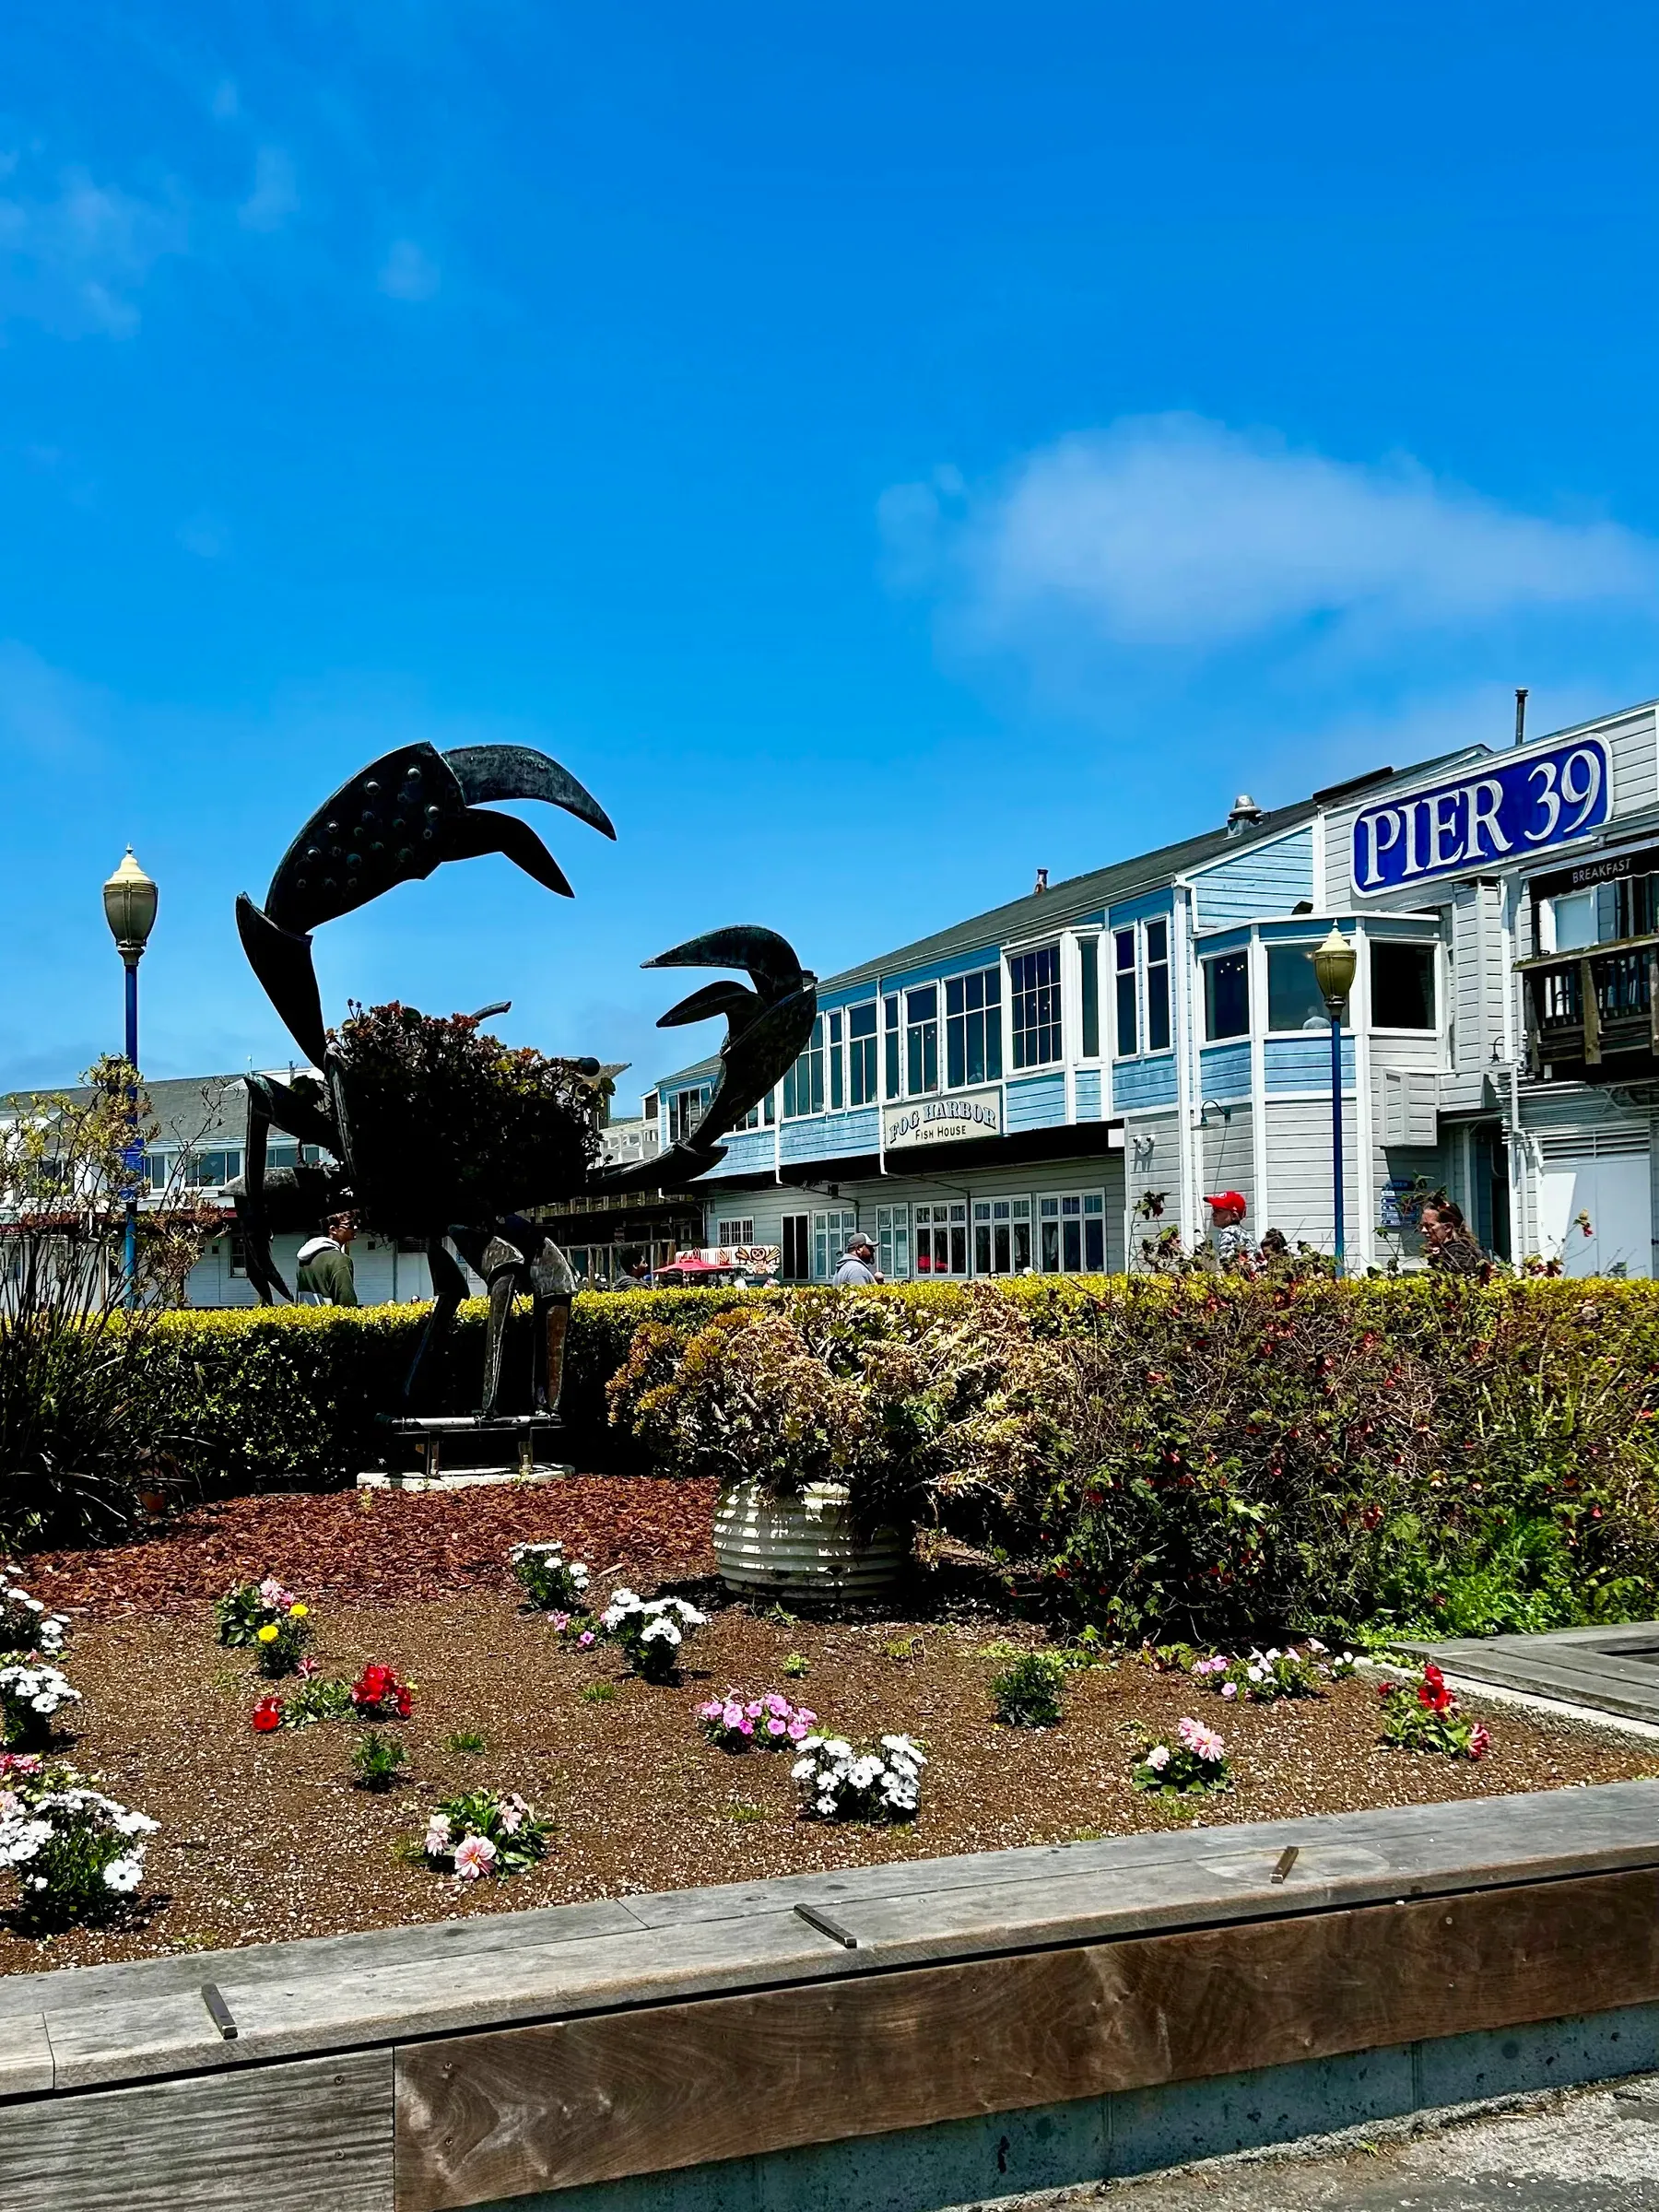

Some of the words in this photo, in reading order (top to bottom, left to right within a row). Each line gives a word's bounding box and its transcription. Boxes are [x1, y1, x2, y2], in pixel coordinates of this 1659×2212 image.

[1360, 780, 1513, 886] PIER
[1524, 749, 1601, 841] 39
[1572, 858, 1632, 883] BREAKFAST
[889, 1111, 920, 1144] FOG
[923, 1101, 996, 1130] HARBOR
[915, 1129, 934, 1140] FISH
[937, 1125, 966, 1136] HOUSE
